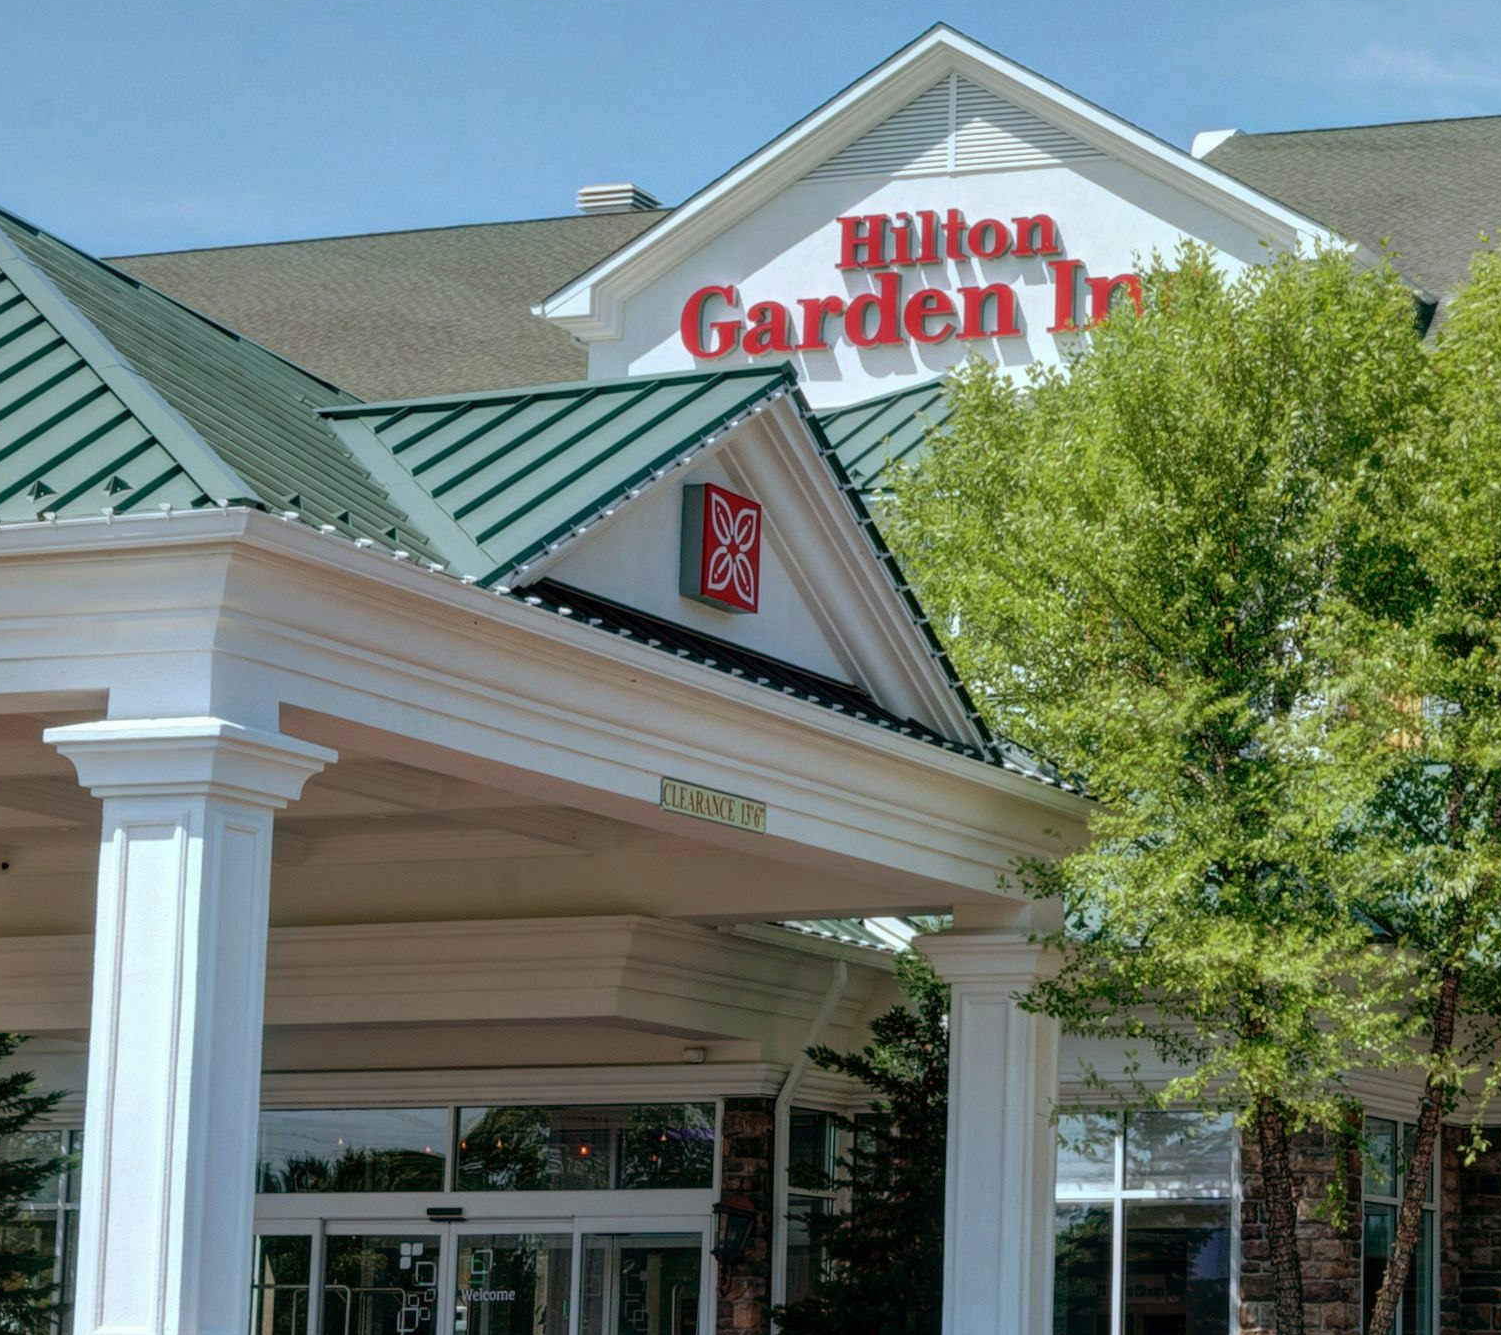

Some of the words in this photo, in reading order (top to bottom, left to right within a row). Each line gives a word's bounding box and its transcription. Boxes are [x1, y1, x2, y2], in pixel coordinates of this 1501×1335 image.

[835, 208, 1062, 270] Hilton
[680, 272, 1022, 360] Garden
[1046, 259, 1183, 333] In
[663, 783, 735, 822] CLEARANCE
[461, 1288, 516, 1302] Welcome
